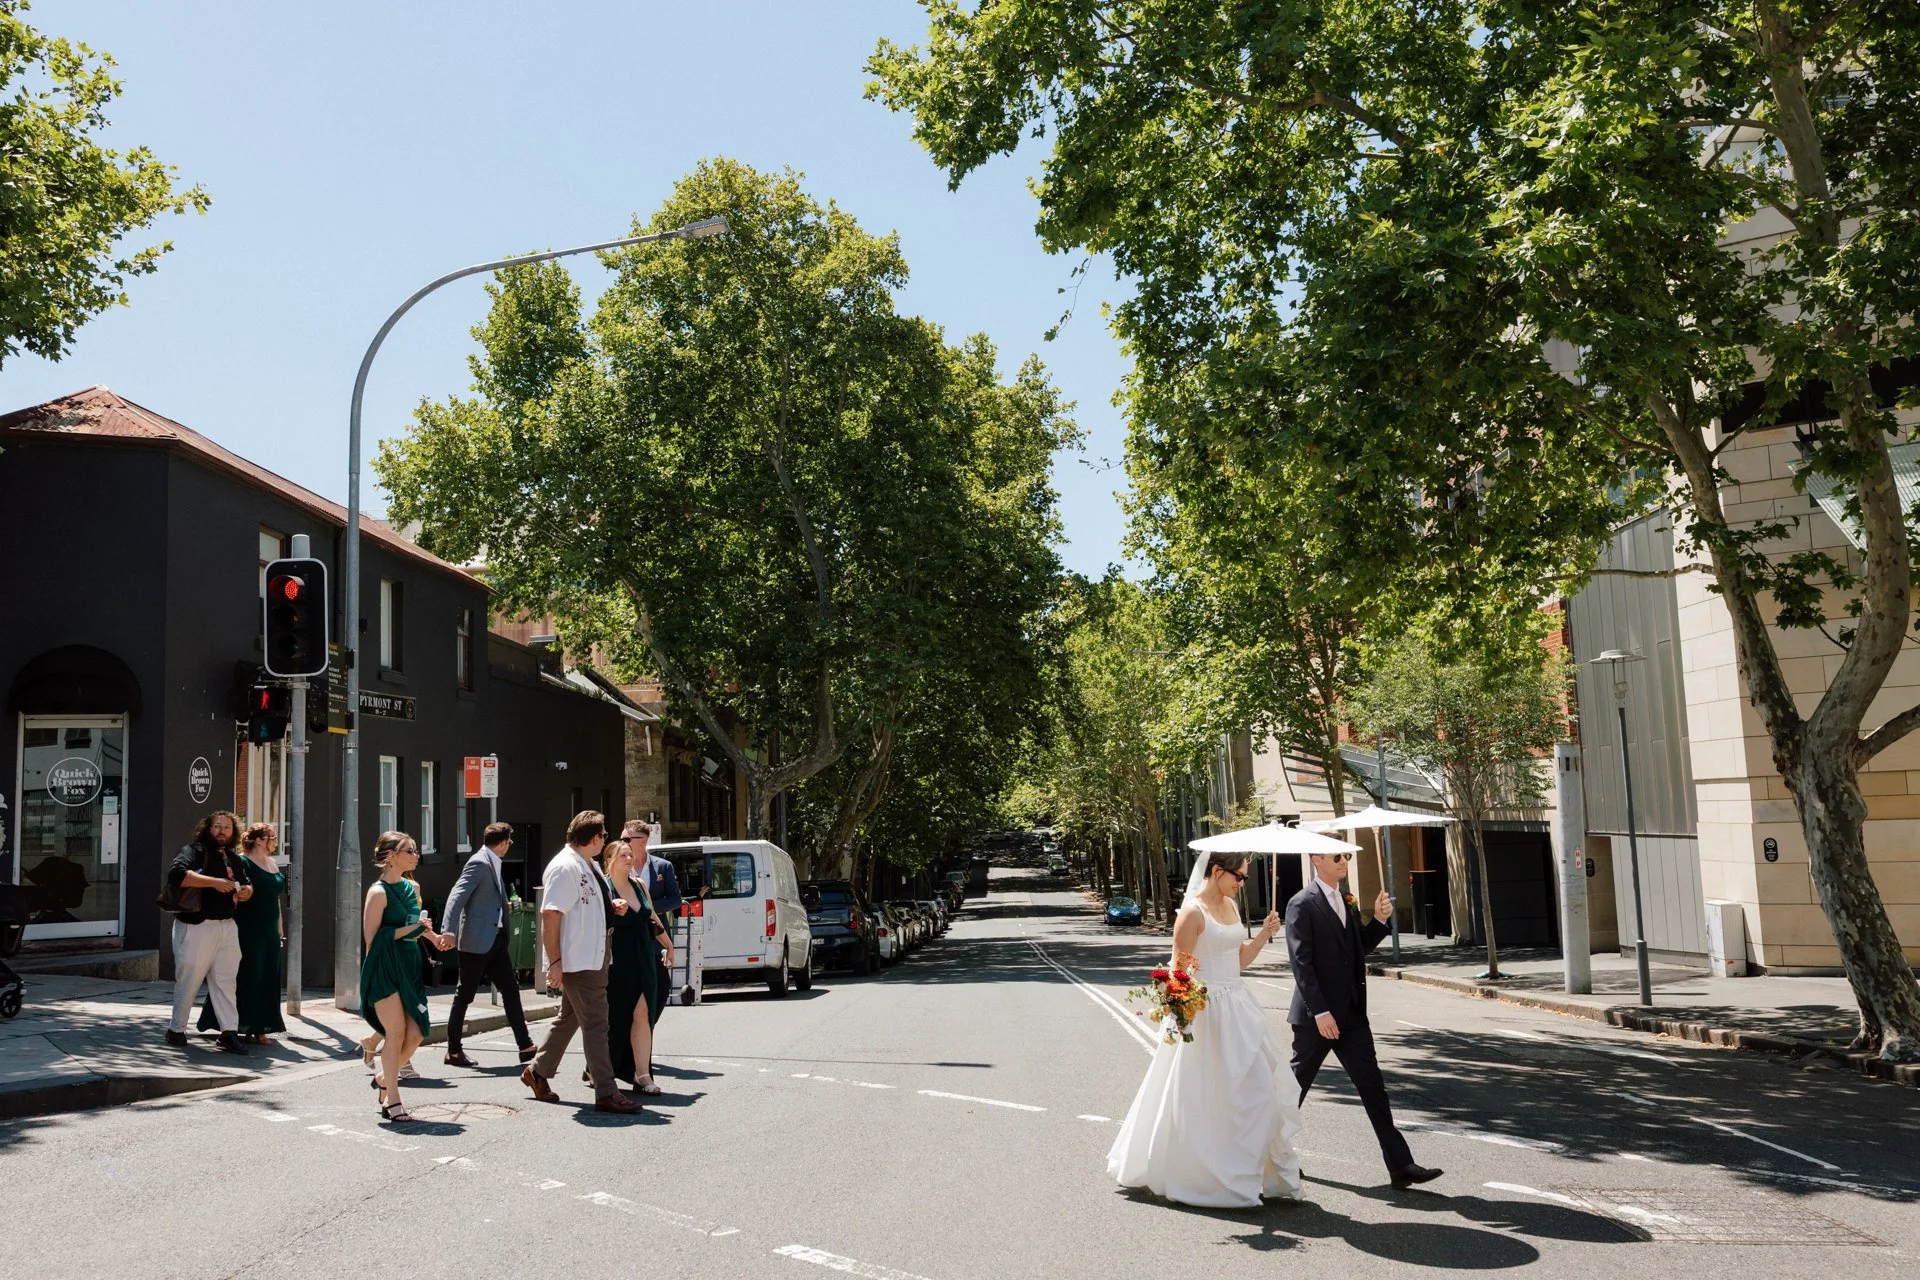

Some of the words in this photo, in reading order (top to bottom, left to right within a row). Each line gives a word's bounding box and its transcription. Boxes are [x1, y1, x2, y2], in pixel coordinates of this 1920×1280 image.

[359, 694, 391, 710] PYRMONT
[393, 699, 402, 711] ST
[54, 768, 95, 779] Quick
[192, 767, 209, 777] Quick
[51, 777, 97, 787] Brown
[191, 775, 210, 785] Brown
[63, 785, 86, 795] Fox
